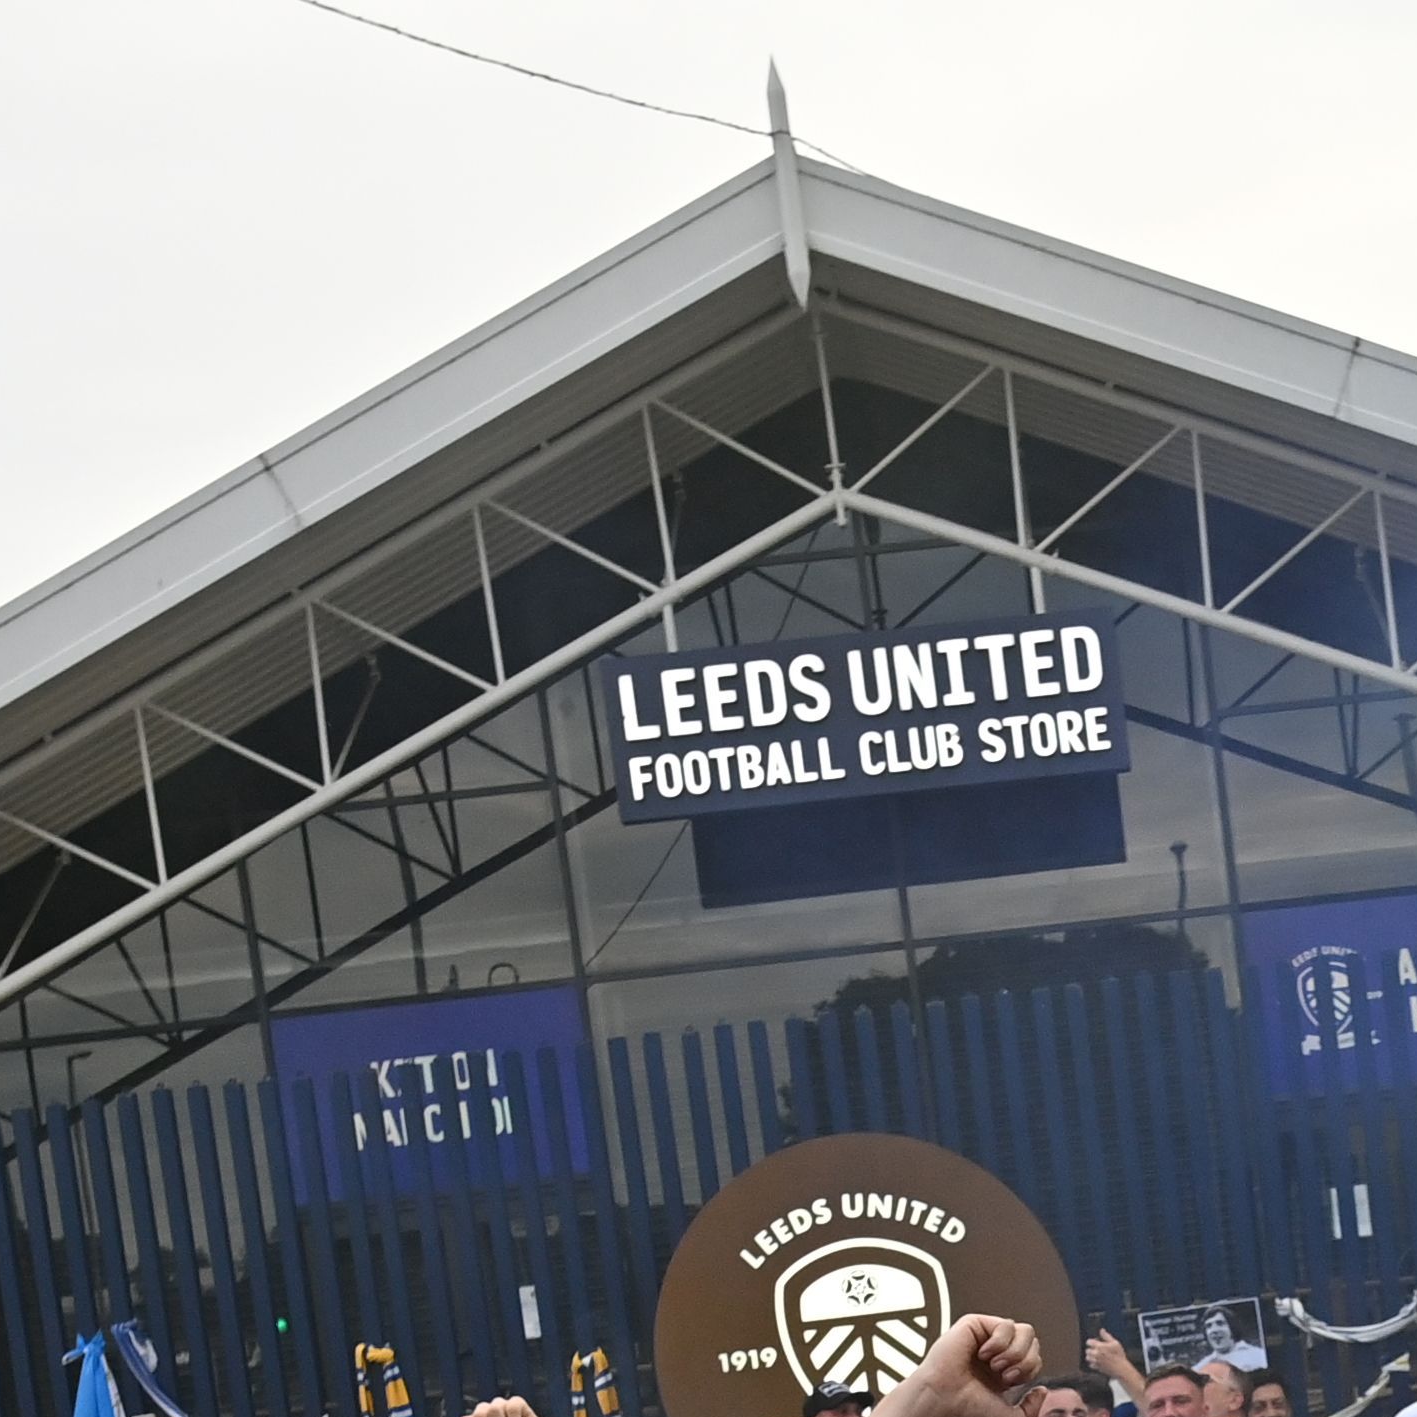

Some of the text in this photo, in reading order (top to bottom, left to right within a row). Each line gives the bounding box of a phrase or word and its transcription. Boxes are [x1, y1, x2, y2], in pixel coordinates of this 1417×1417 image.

[616, 625, 1104, 742] LEEDS UNITED
[628, 706, 1112, 801] FOOTBALL CLUB STORE
[740, 1192, 967, 1270] LEEDS UNITED
[718, 1346, 778, 1374] 1919
